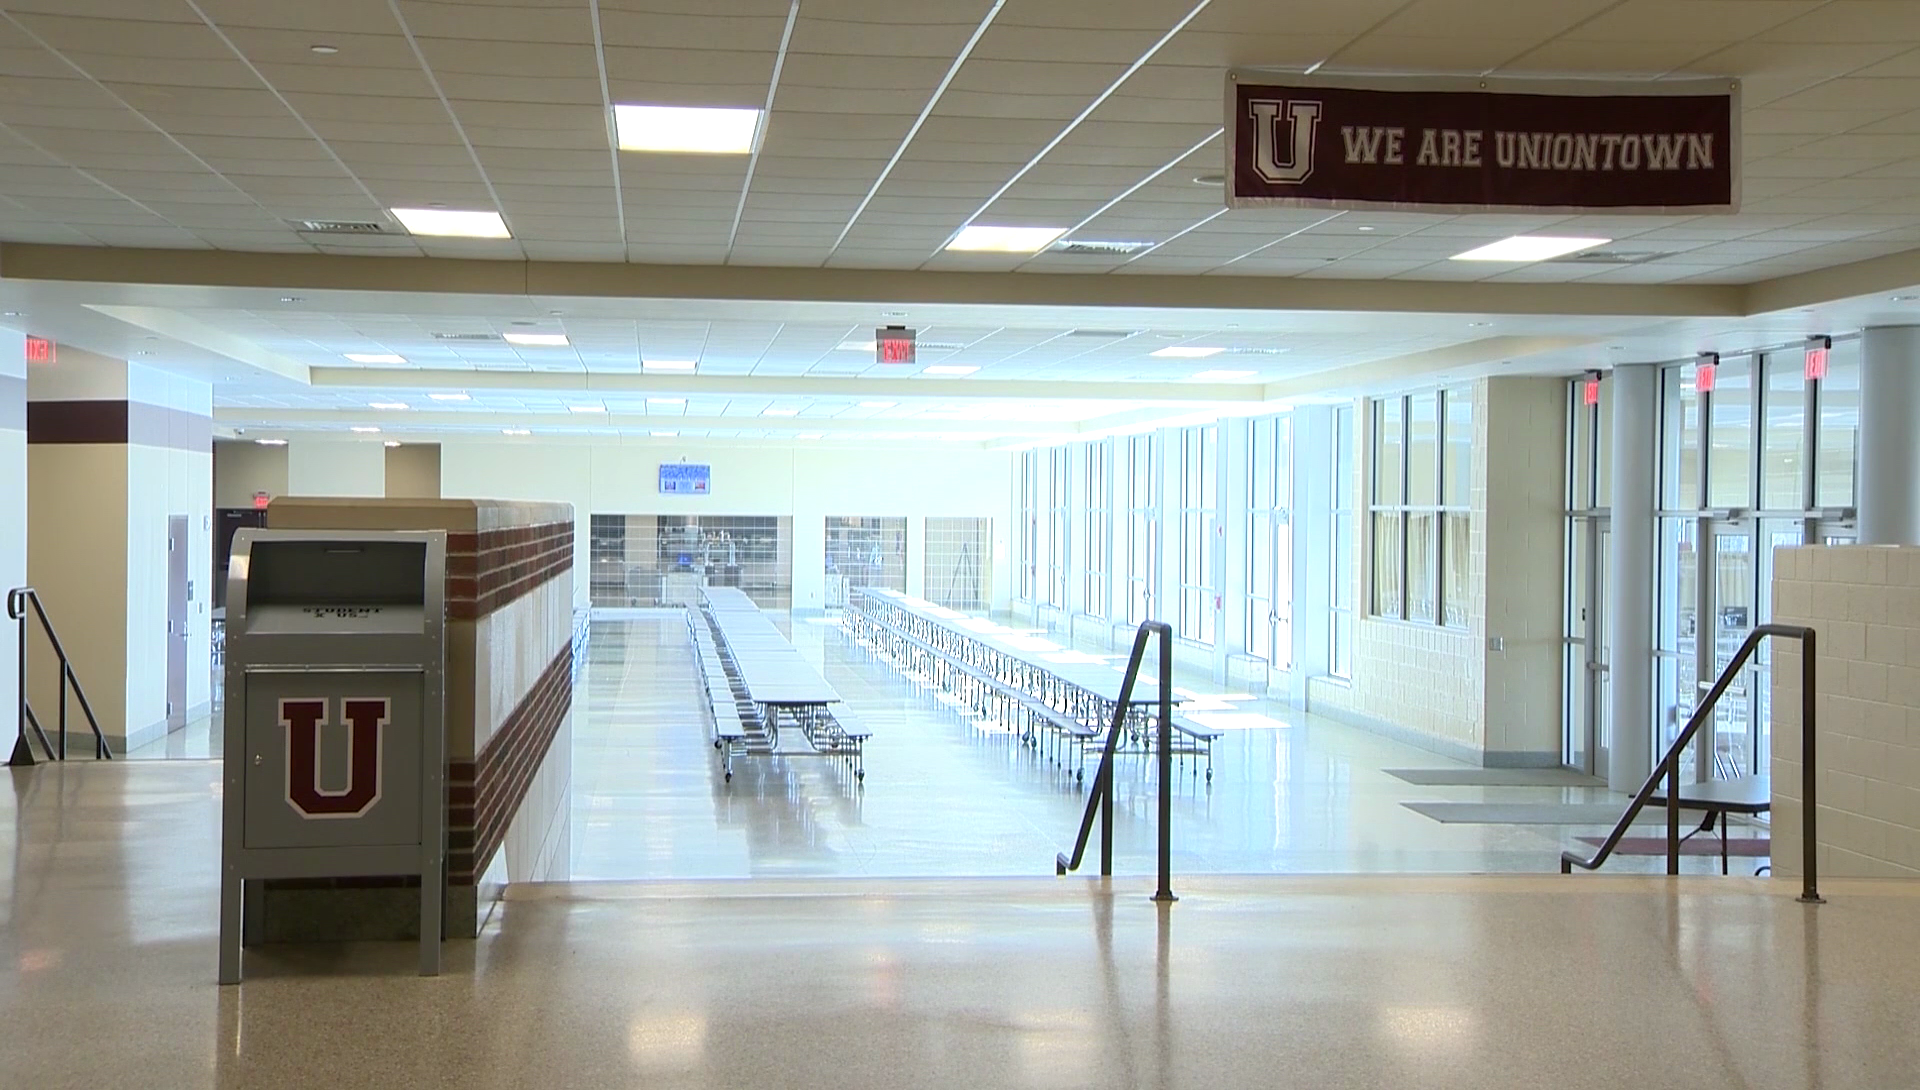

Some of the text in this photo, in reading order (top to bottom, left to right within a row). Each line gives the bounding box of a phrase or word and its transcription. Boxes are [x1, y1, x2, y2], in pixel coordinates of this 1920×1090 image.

[1249, 99, 1322, 184] U
[1341, 126, 1714, 170] WE ARE UNIONTOWN
[884, 339, 909, 360] EXIT
[278, 697, 391, 819] U
